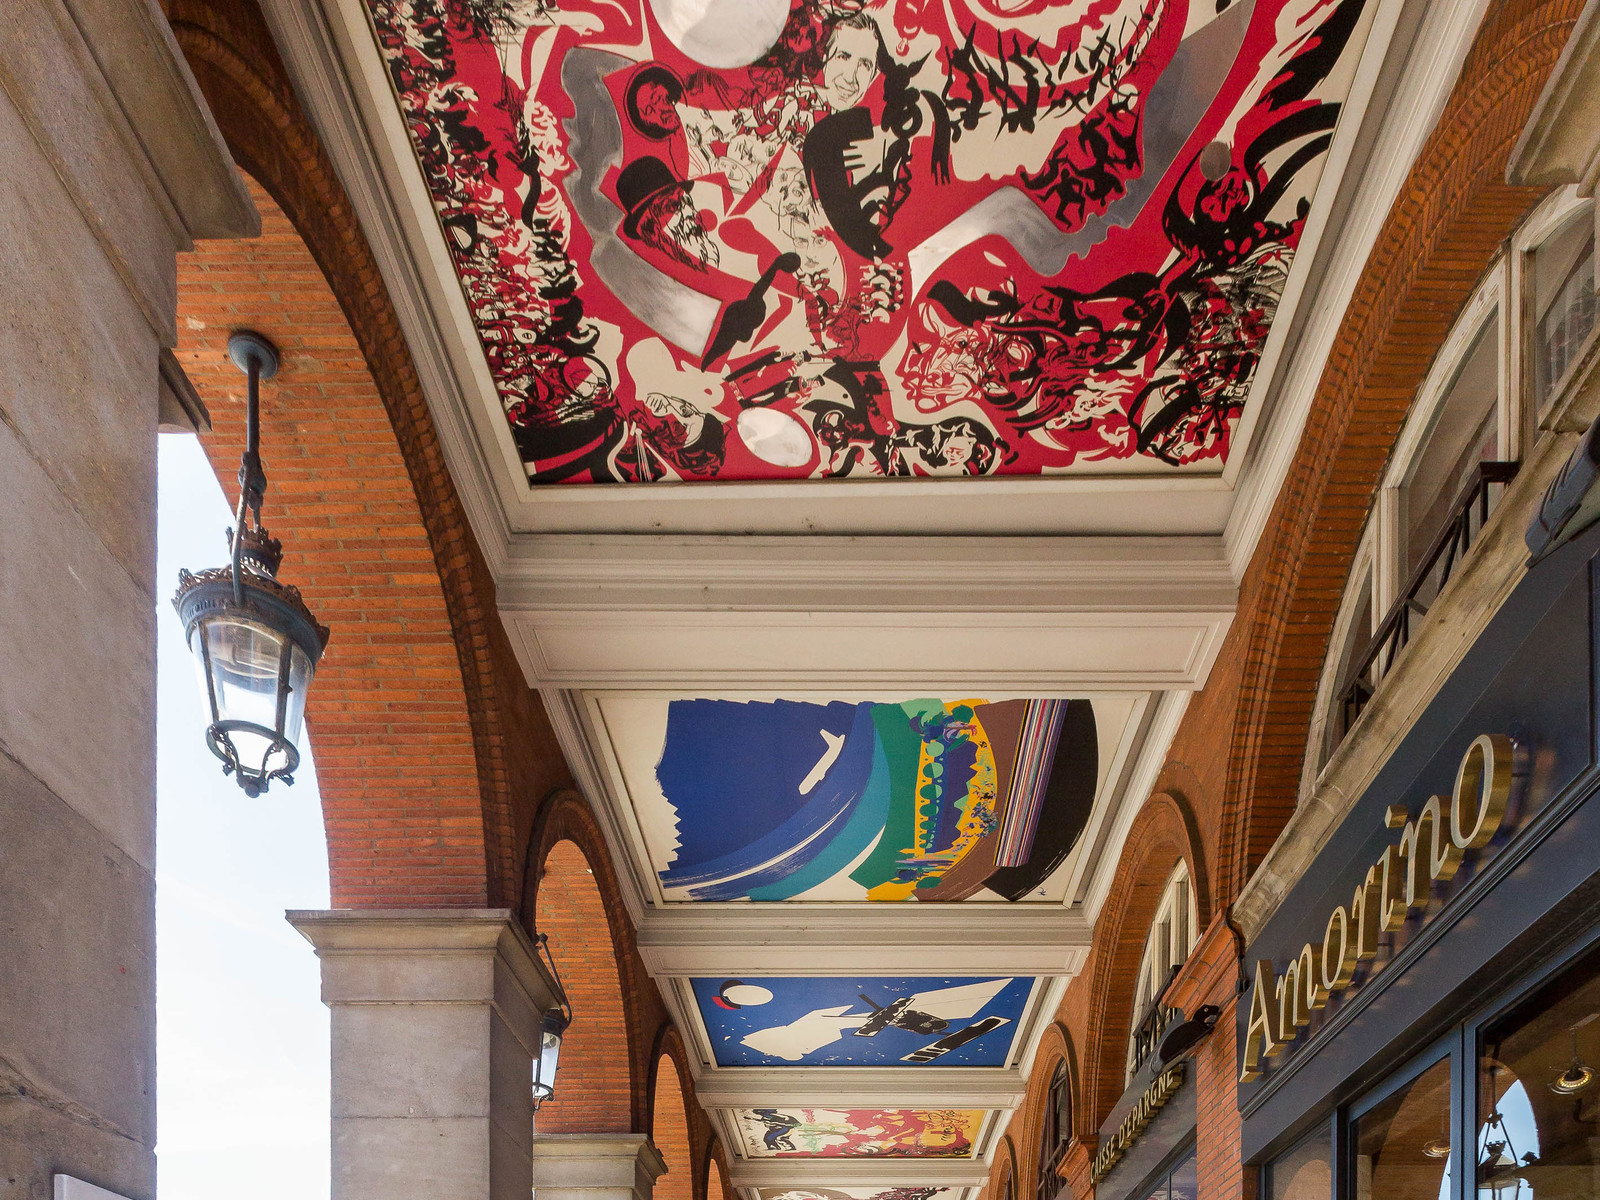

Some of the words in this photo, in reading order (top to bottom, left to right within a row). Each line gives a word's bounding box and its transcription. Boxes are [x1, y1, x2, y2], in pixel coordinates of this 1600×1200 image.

[1239, 733, 1506, 1083] Amorino
[1090, 1133, 1118, 1184] CAISSE
[1118, 1069, 1178, 1150] D'EPARGNE
